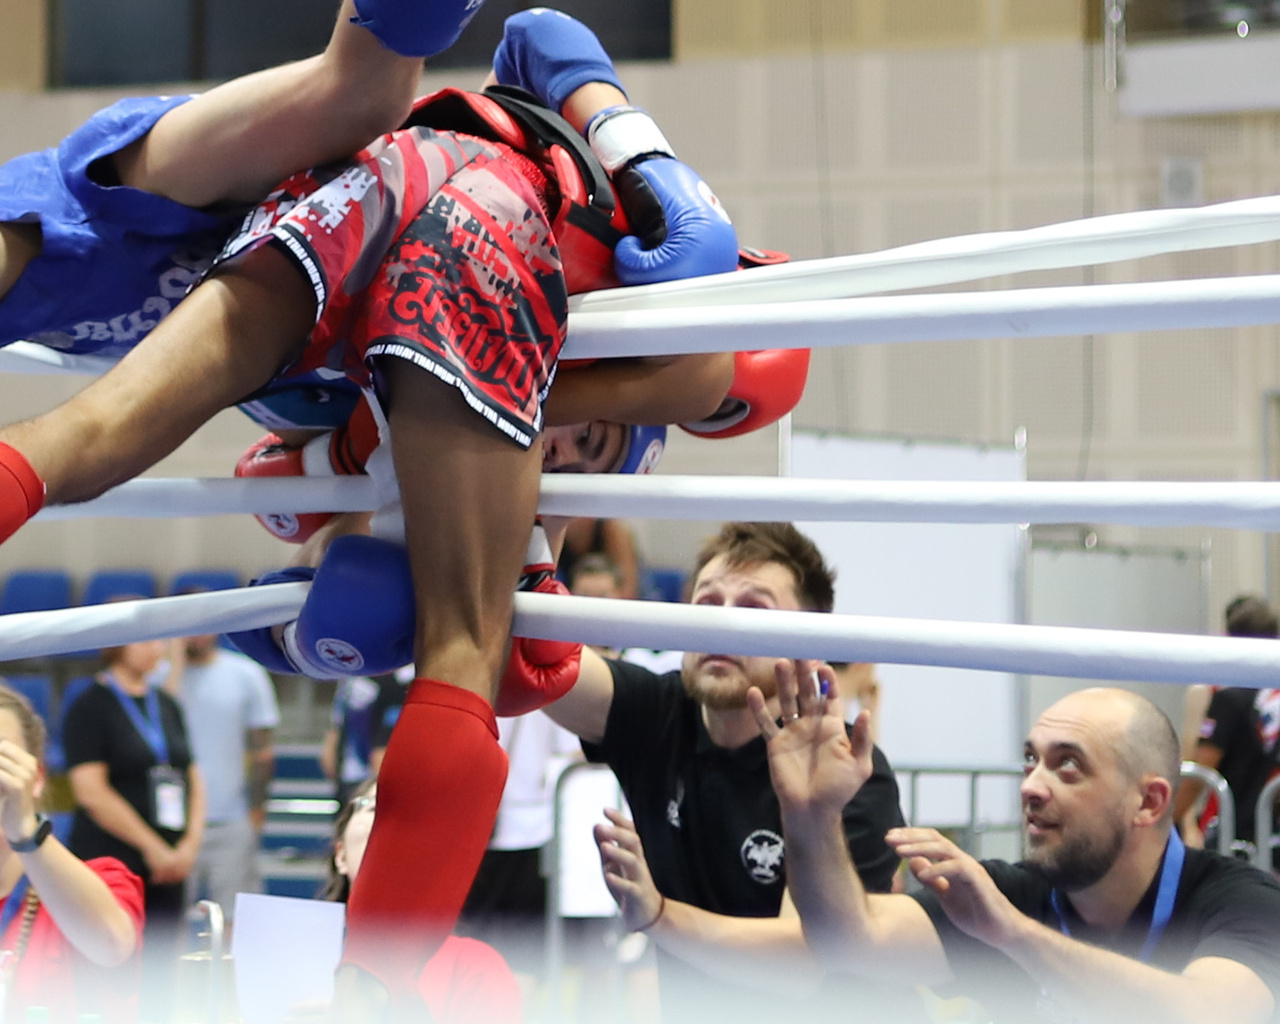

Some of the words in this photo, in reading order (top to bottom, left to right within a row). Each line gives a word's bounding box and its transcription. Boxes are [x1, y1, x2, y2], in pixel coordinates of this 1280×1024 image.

[286, 237, 306, 260] THAI
[302, 257, 321, 285] MUAY
[385, 344, 415, 360] MUAY
[413, 352, 435, 373] THAI
[433, 364, 456, 386] MUAY
